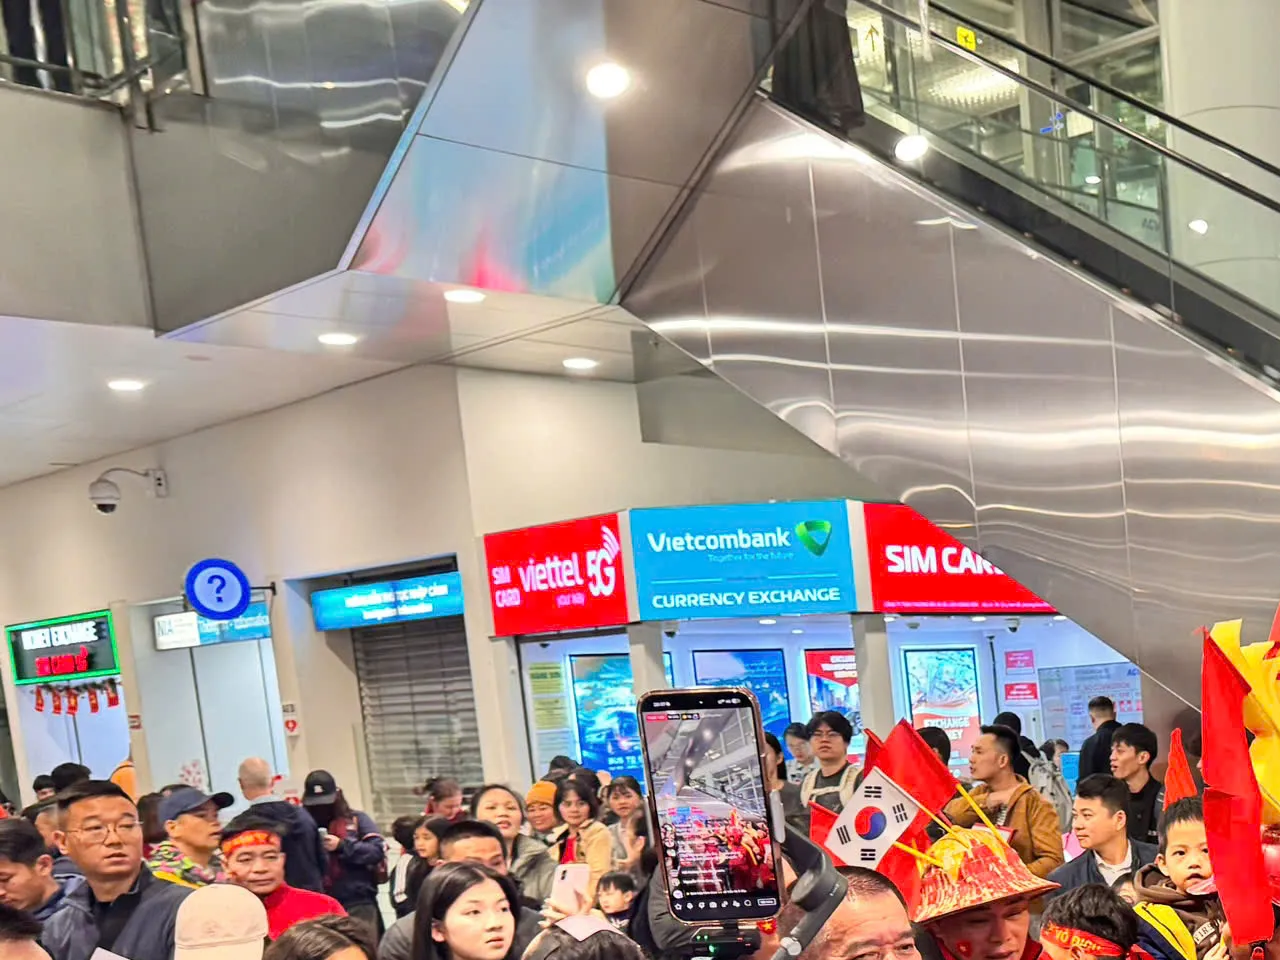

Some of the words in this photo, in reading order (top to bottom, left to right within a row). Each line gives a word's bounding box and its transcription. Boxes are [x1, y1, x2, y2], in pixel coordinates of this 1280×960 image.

[647, 526, 791, 552] Vietcombank
[885, 545, 937, 573] SIM
[941, 545, 1005, 575] CAR
[491, 565, 511, 585] SIM
[518, 552, 584, 593] viettel
[586, 548, 616, 597] 5G
[495, 588, 521, 608] CARD
[652, 591, 745, 609] CURRENCY
[748, 587, 841, 605] EXCHANGE
